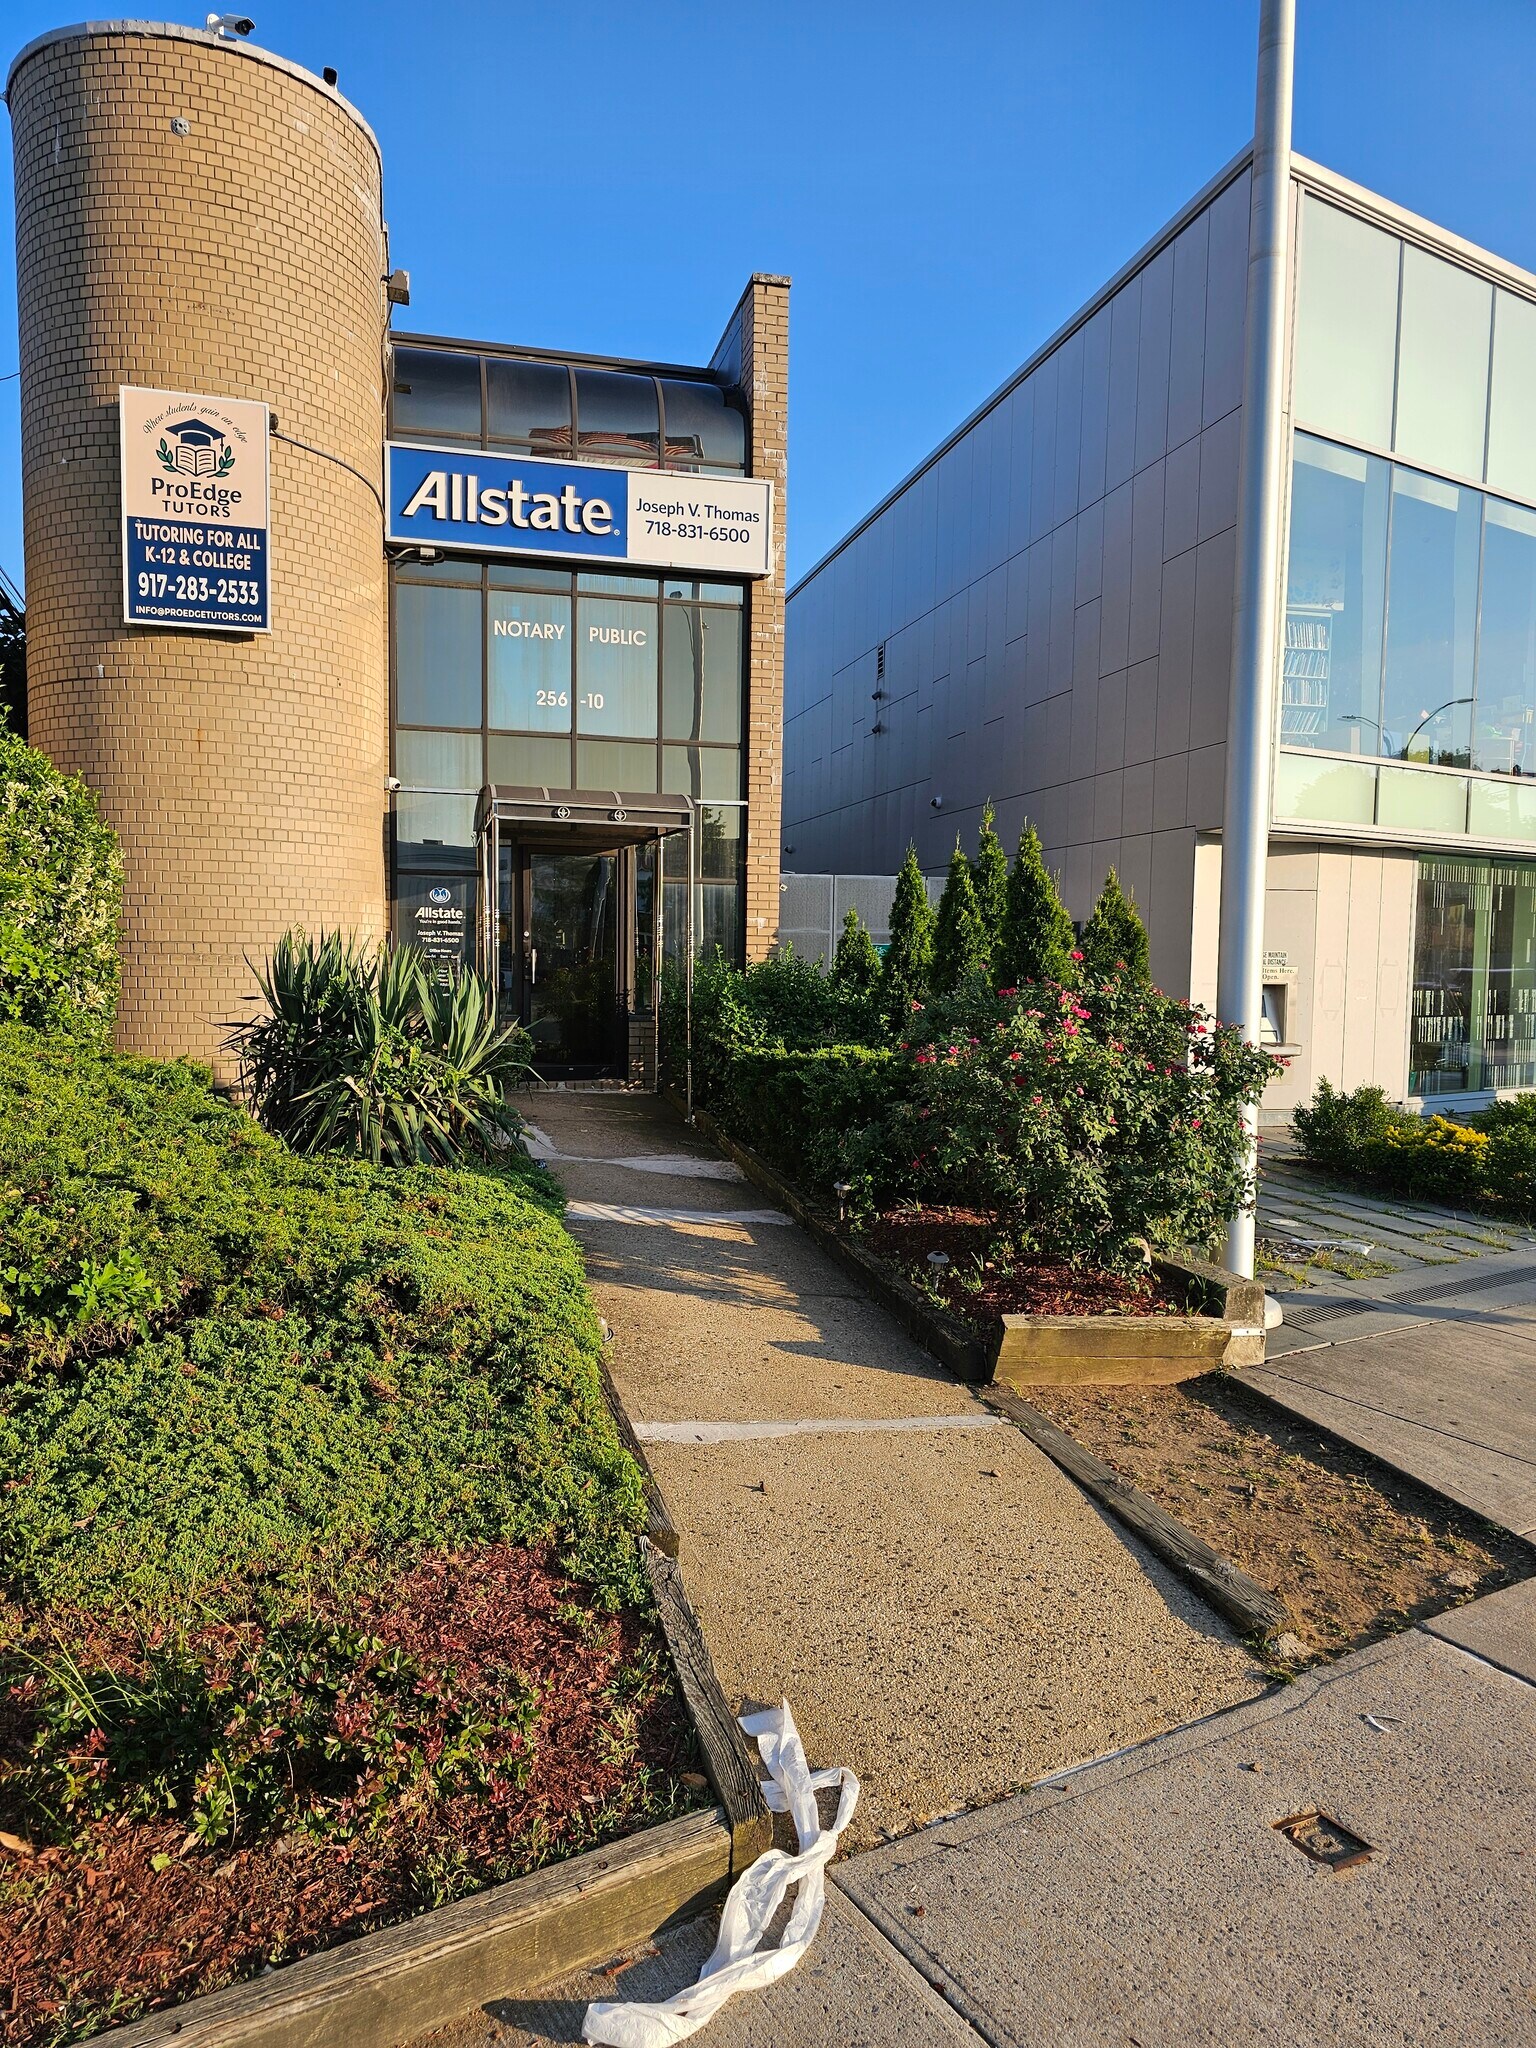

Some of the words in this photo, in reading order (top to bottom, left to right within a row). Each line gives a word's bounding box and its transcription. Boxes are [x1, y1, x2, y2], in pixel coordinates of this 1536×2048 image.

[143, 413, 164, 434] Where
[165, 402, 197, 417] students
[197, 406, 220, 417] gain
[221, 415, 233, 426] an
[232, 426, 248, 444] edge
[151, 477, 242, 506] ProEdge
[402, 471, 613, 536] Allstate
[162, 500, 231, 518] TUTORS
[636, 498, 684, 517] Joseph
[688, 503, 701, 518] V.
[704, 504, 760, 523] Thomas
[135, 522, 204, 546] TUTORING
[207, 529, 234, 548] FOR
[237, 532, 260, 550] ALL
[645, 520, 750, 543] 718-831-6500
[145, 546, 176, 564] K-12
[179, 548, 191, 566] &
[193, 550, 251, 570] COLLEGE
[138, 572, 259, 606] 917-283-2533
[135, 605, 262, 623] INFO@PROEDGETUTORS.COM
[494, 620, 565, 640] NOTARY
[589, 626, 647, 646] PUBLIC
[536, 690, 568, 707] 256
[580, 693, 604, 709] -10
